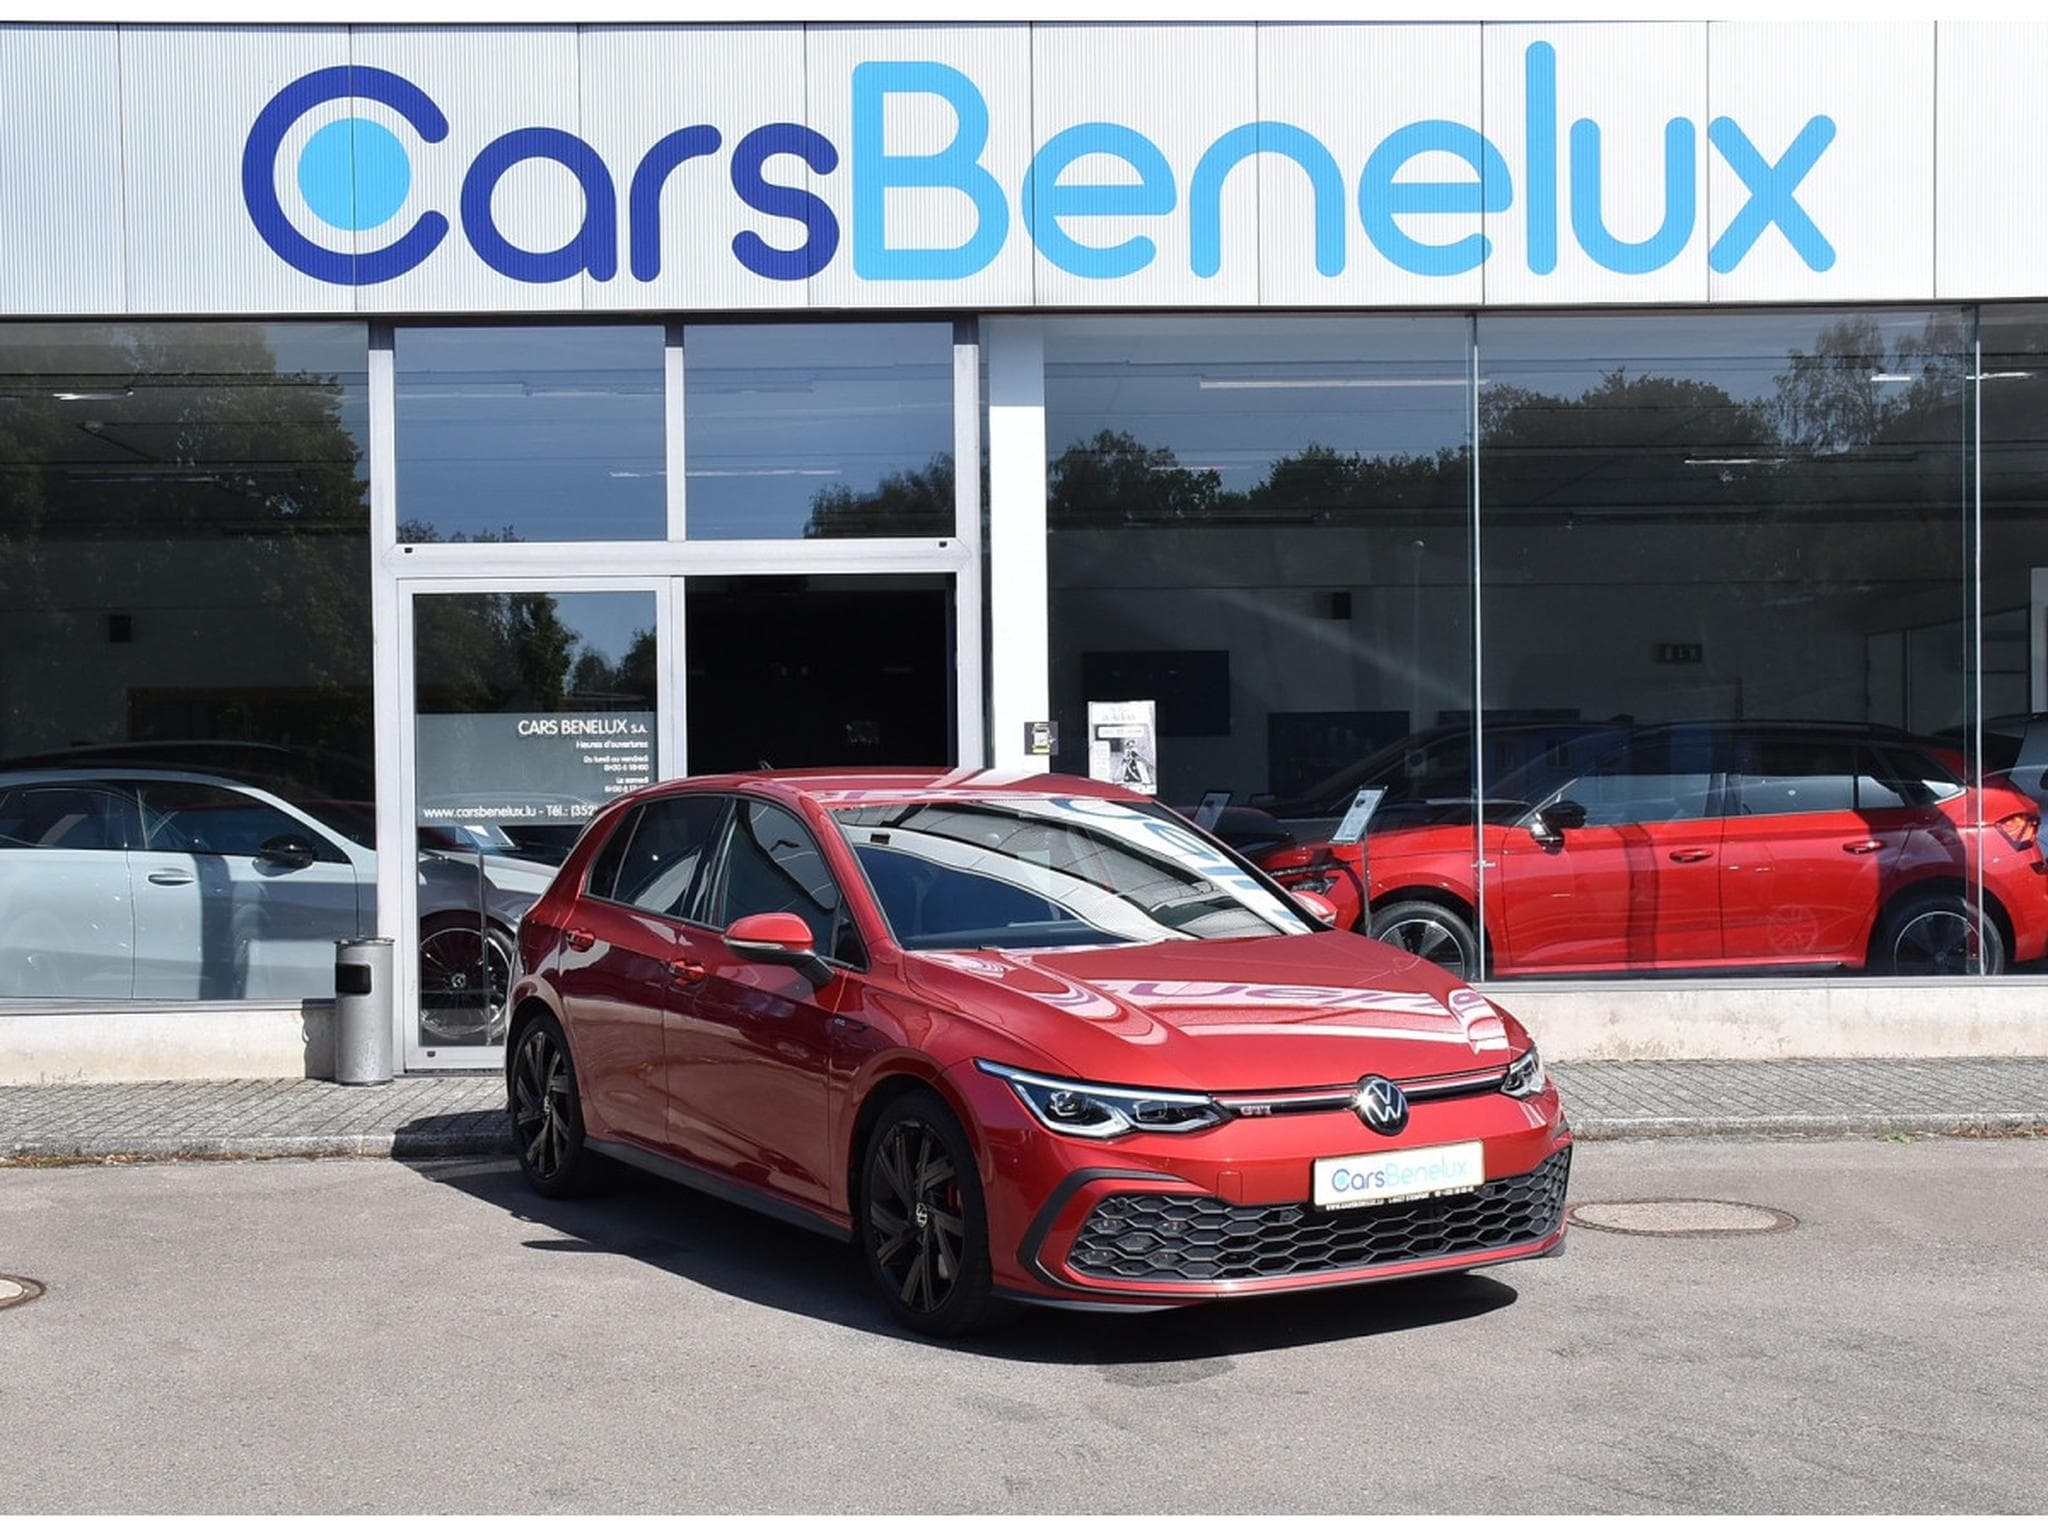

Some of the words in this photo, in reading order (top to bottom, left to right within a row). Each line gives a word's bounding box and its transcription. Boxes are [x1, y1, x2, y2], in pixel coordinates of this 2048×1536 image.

[242, 41, 1837, 285] CarsBenelux
[518, 719, 558, 735] CARS
[561, 718, 628, 735] BENELUX
[423, 805, 537, 819] www.carsbenelux.lu
[1332, 1154, 1467, 1193] CarsBenelux
